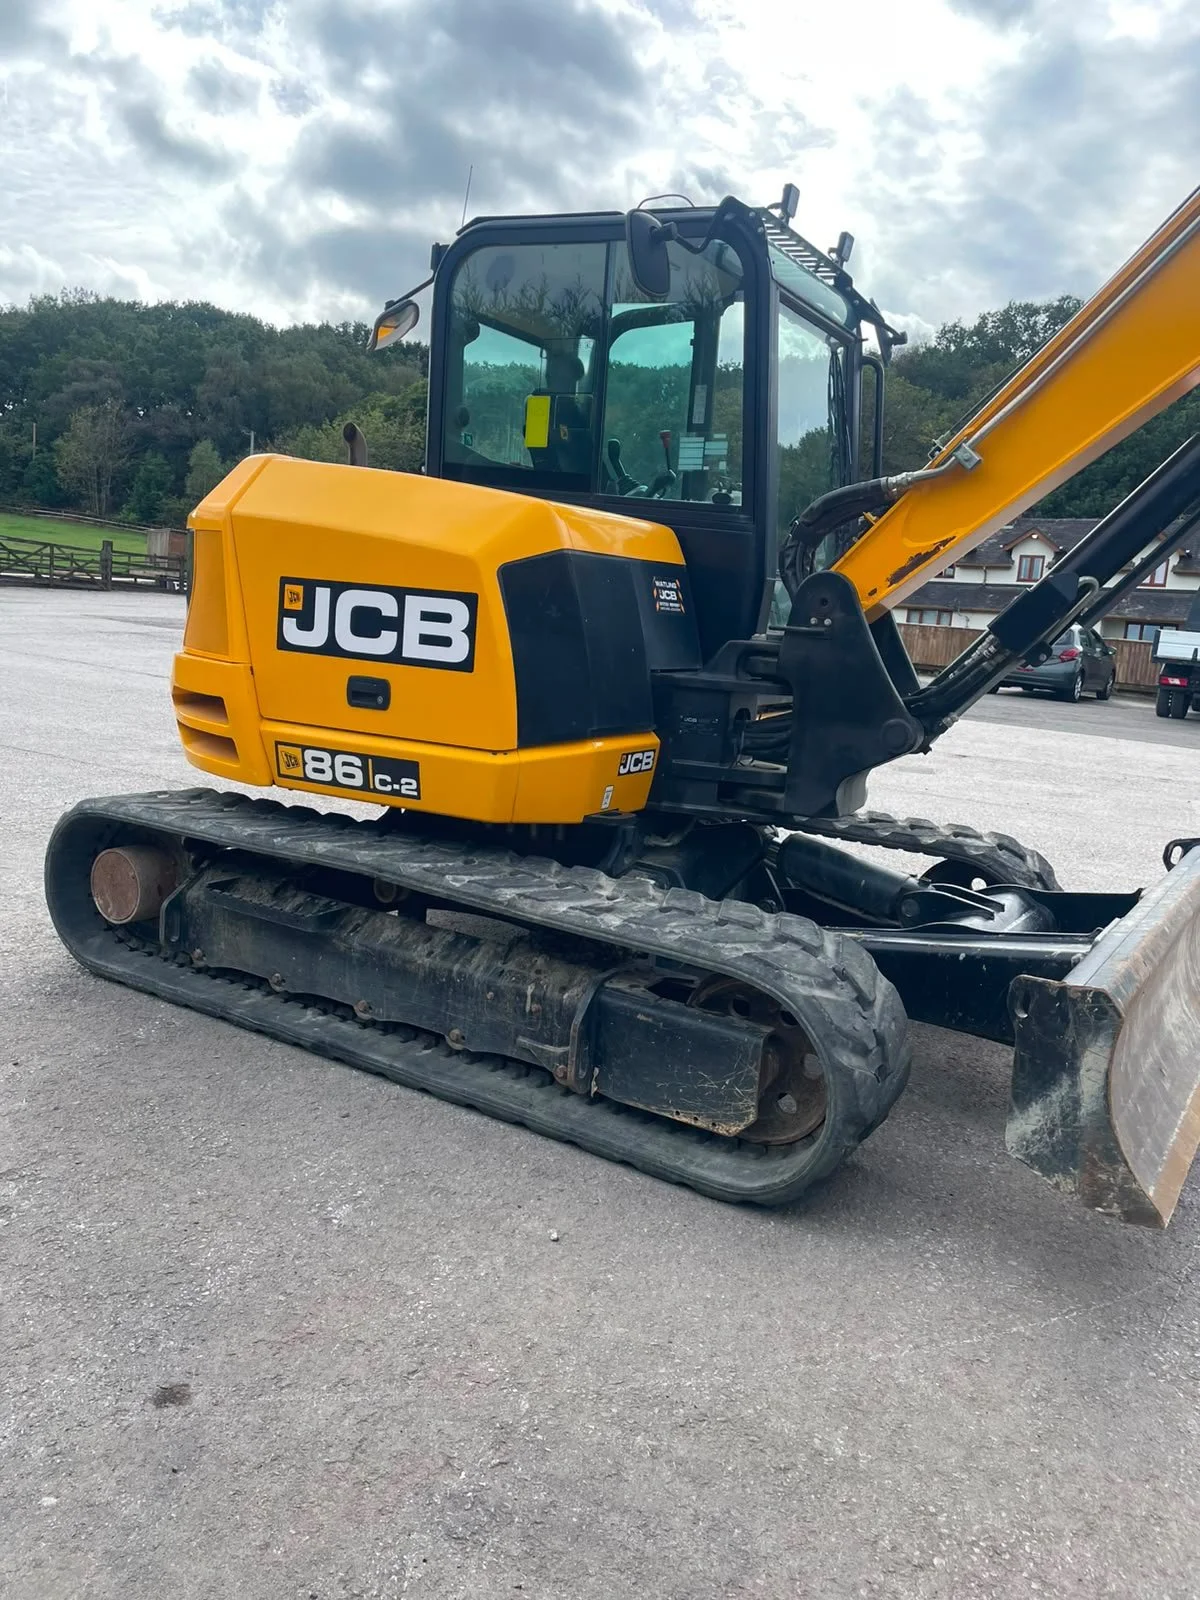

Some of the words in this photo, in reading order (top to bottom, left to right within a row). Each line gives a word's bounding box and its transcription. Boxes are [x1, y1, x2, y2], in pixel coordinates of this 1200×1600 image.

[659, 589, 677, 600] JCB
[282, 586, 470, 664] JCB
[281, 750, 299, 770] JCB
[303, 749, 364, 787] 86
[374, 774, 418, 796] C-2
[619, 750, 655, 774] JCB
